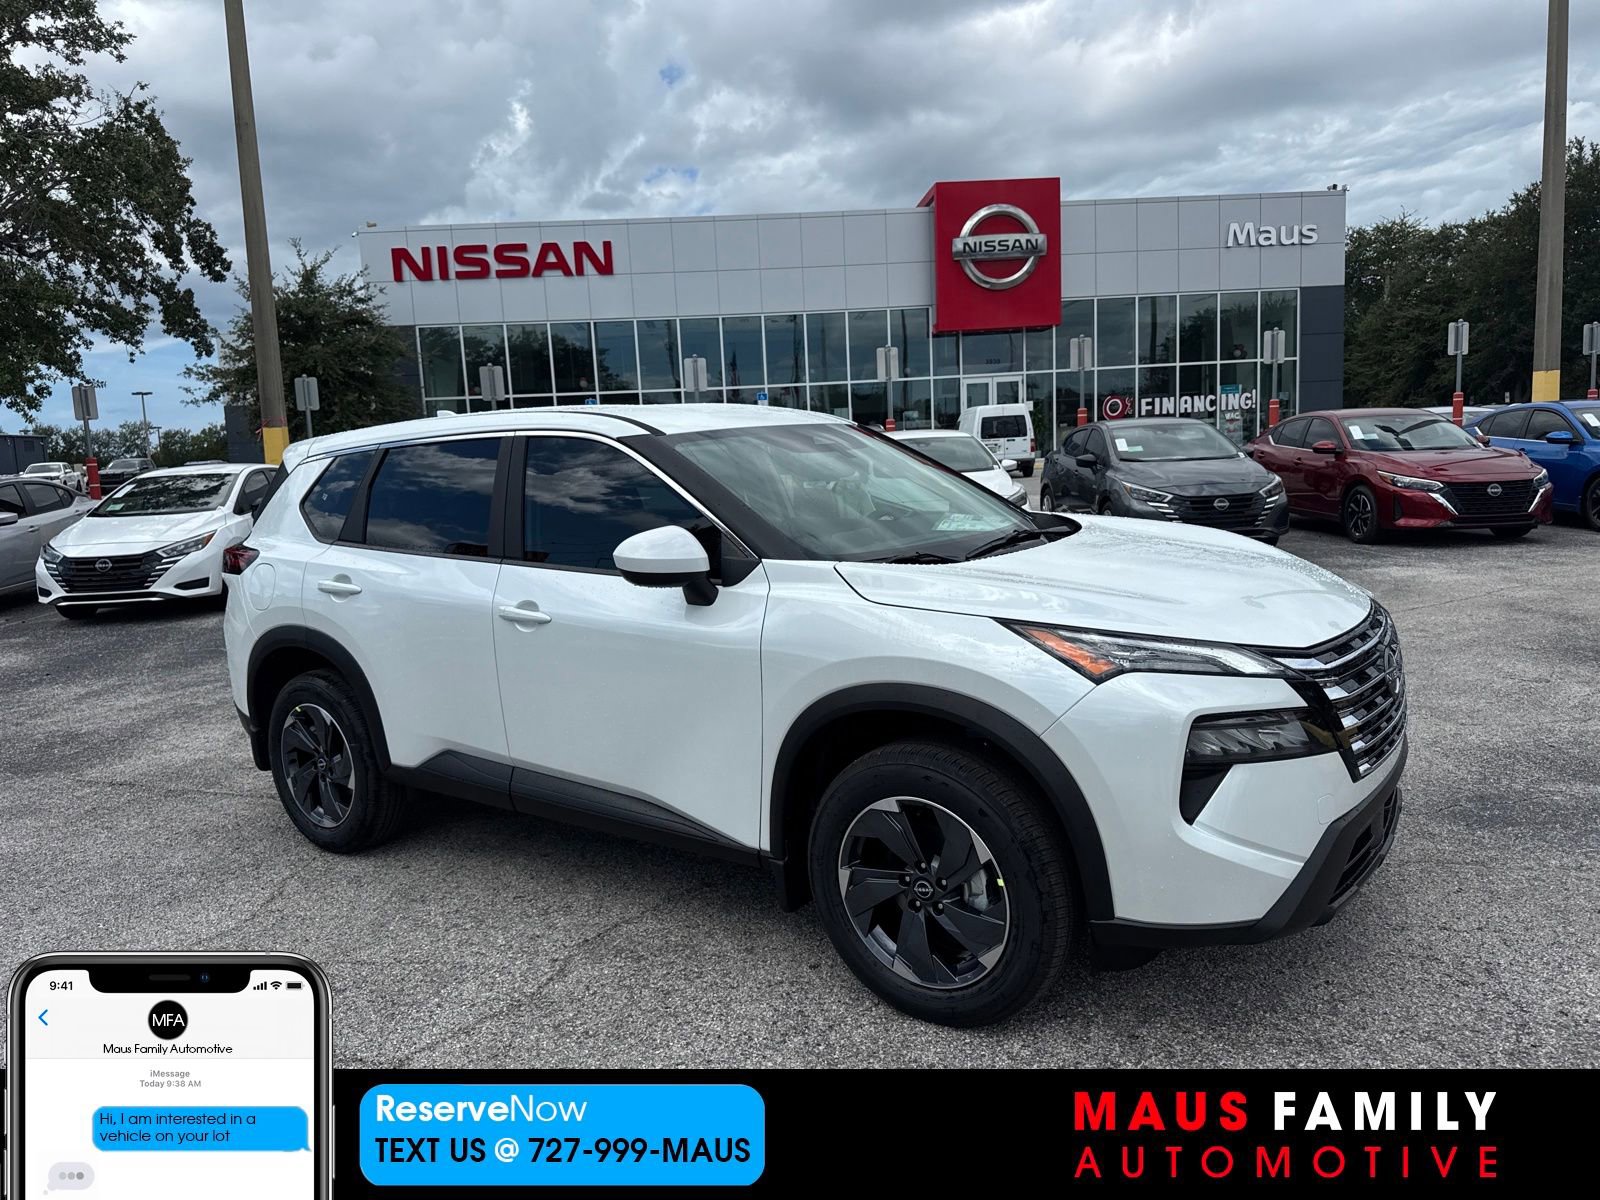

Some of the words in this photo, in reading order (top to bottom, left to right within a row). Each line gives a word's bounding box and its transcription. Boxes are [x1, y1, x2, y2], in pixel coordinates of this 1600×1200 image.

[962, 238, 1038, 254] NISSAN
[1227, 222, 1319, 247] Maus
[391, 240, 614, 282] NISSAN
[1140, 389, 1256, 416] FINANCING!
